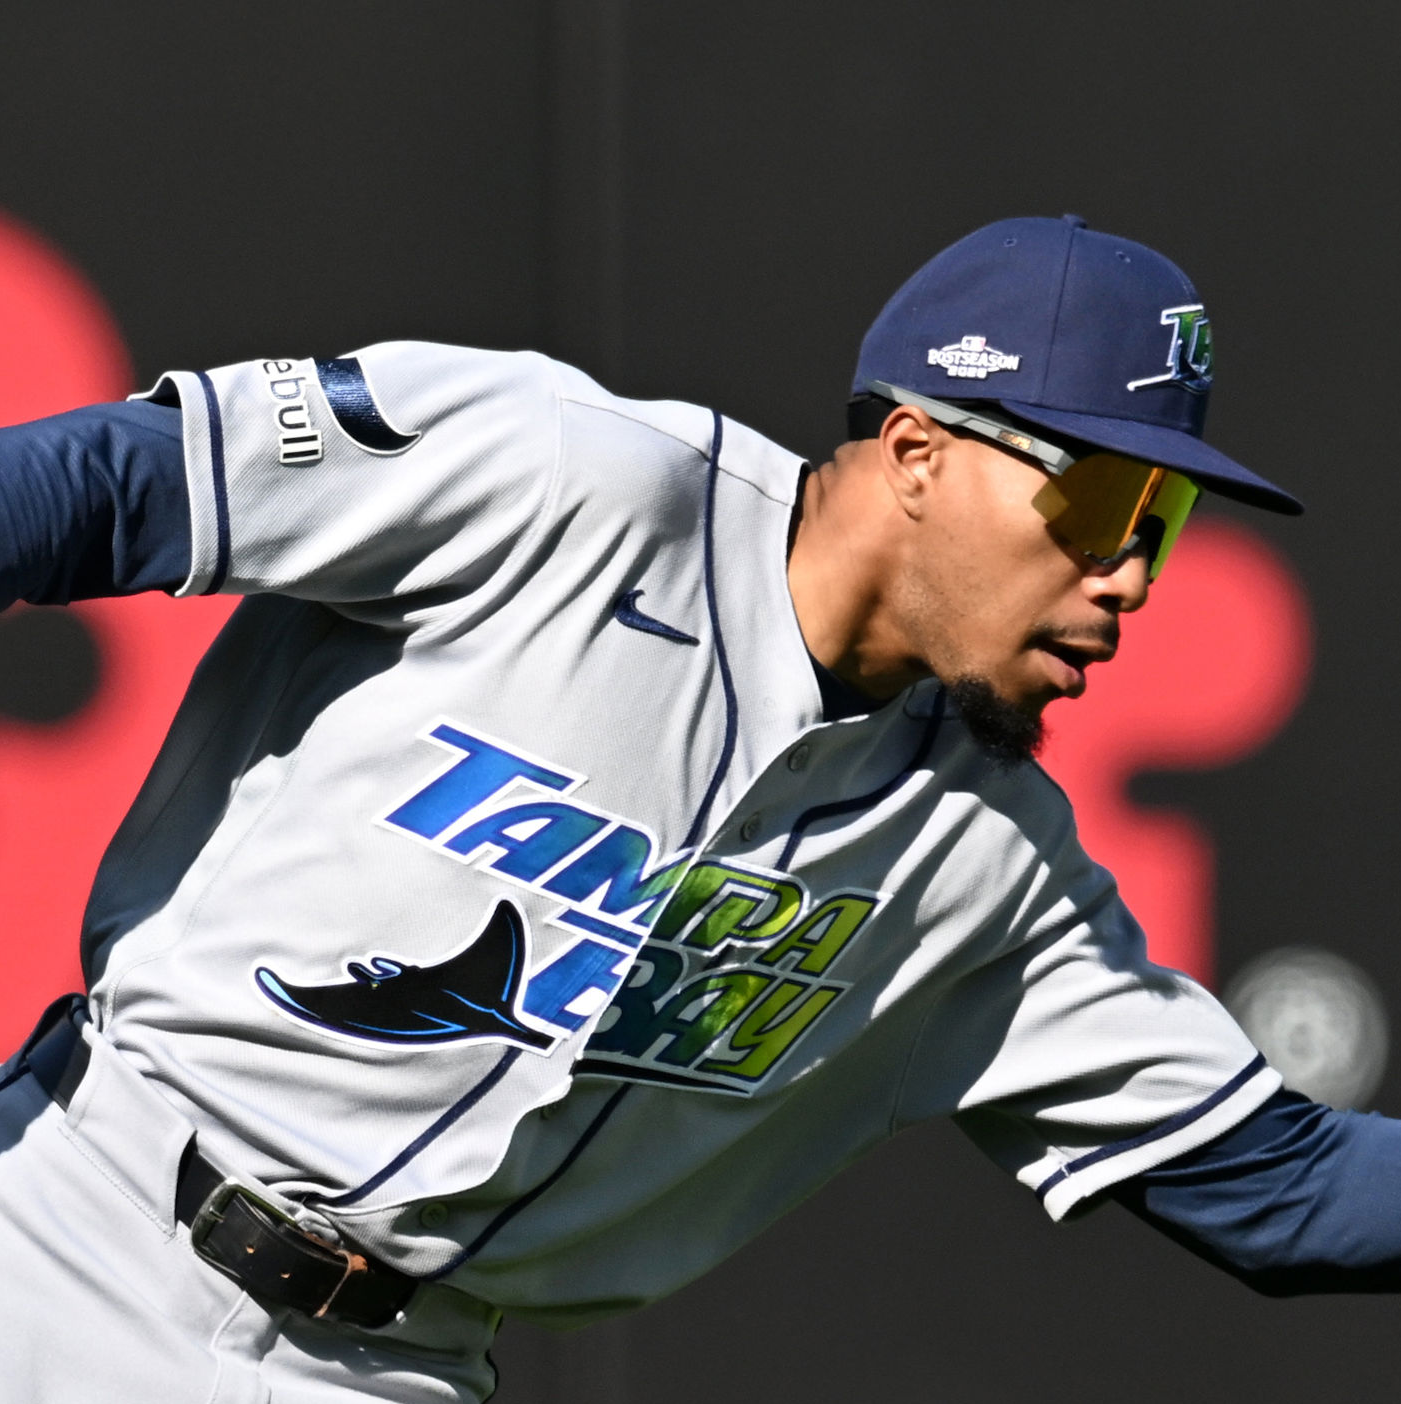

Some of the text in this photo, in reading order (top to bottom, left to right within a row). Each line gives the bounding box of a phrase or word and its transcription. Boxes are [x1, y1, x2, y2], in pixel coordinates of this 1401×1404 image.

[927, 348, 1020, 371] POSTSEASON
[262, 360, 320, 460] ebull
[377, 718, 889, 977] TAMPA
